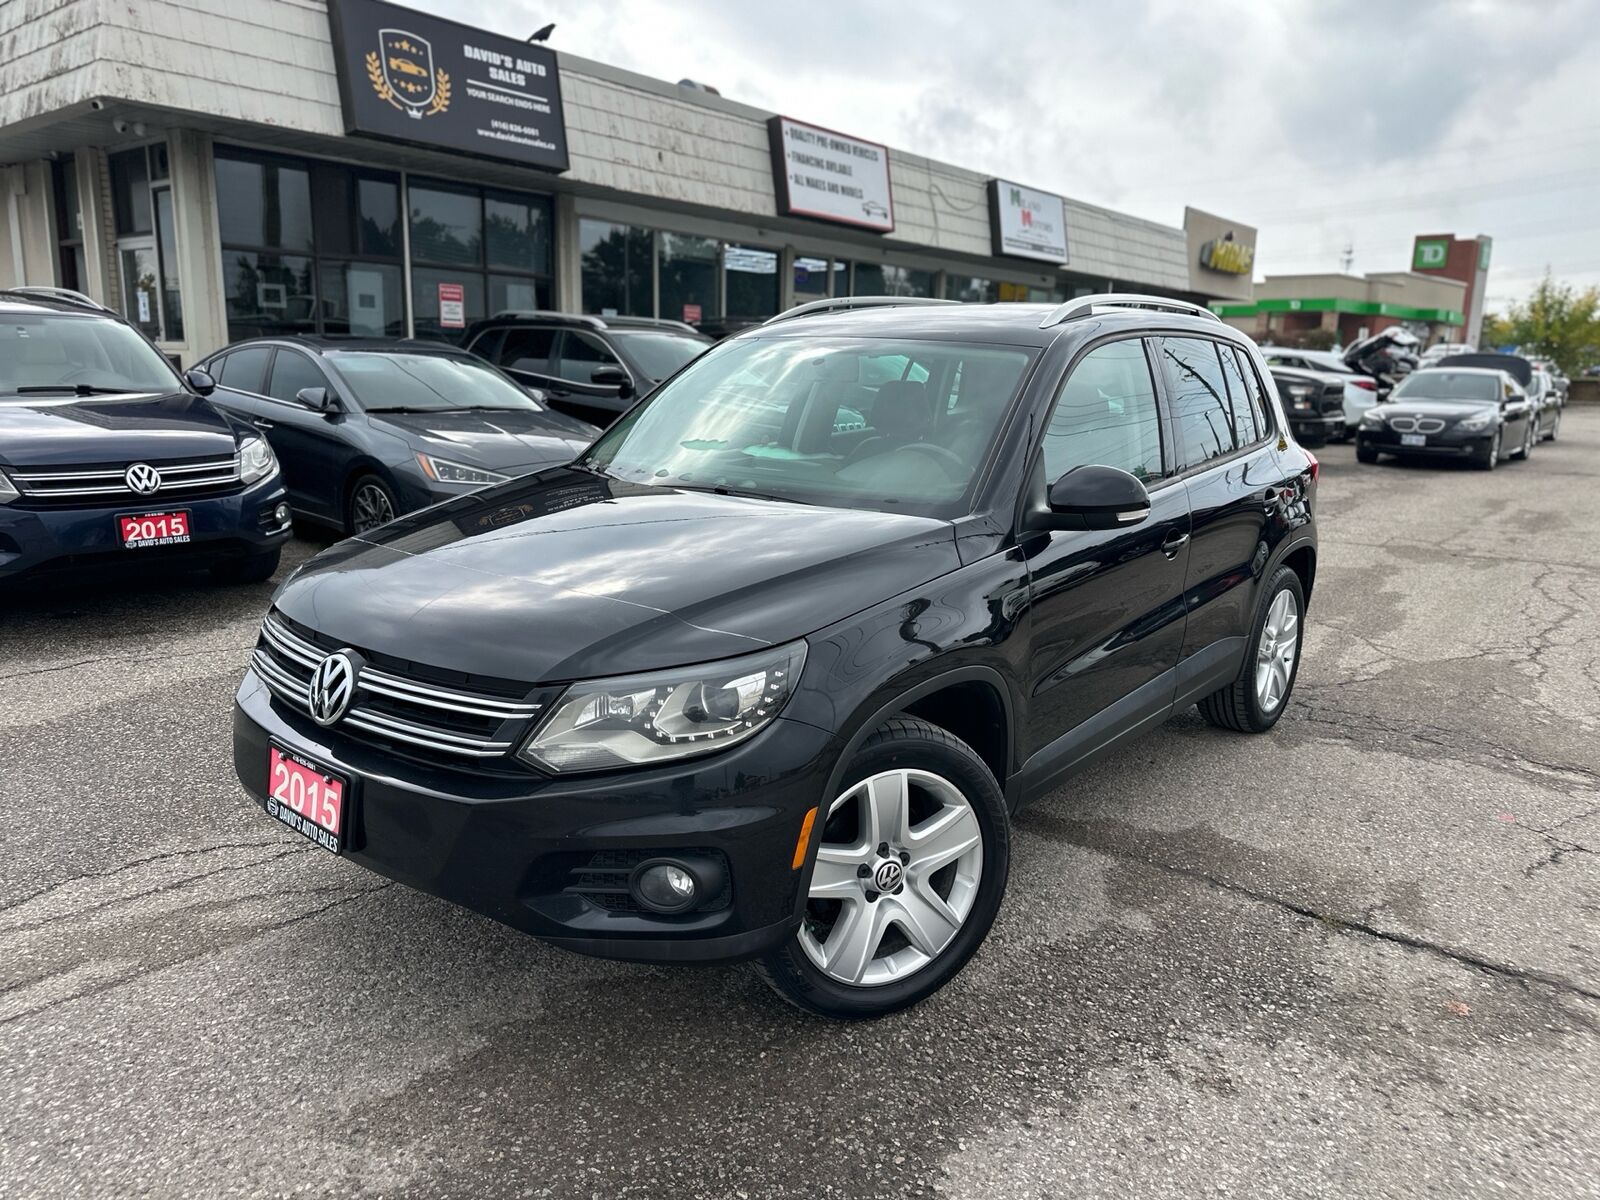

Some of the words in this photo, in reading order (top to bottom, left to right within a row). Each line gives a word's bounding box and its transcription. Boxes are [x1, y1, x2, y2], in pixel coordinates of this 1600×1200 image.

[463, 44, 513, 69] DAVID'S
[516, 58, 547, 77] AUTO
[488, 66, 526, 87] SALES
[466, 87, 487, 99] YOUR
[487, 92, 514, 106] SEARCH
[514, 98, 532, 110] ENDS
[533, 102, 551, 114] HERE
[790, 127, 815, 146] QUALITY
[816, 135, 851, 155] PRE-OWNED
[852, 144, 879, 162] VEHICLES
[791, 150, 824, 170] FINANCING
[794, 173, 804, 187] ALL
[805, 176, 826, 192] MAKES
[827, 181, 840, 194] AND
[841, 185, 864, 200] MODELS
[1419, 245, 1444, 263] TD
[126, 518, 185, 542] 2015
[137, 538, 159, 548] DAVID'S
[159, 537, 173, 545] AUTO
[173, 535, 191, 543] SALES
[273, 763, 338, 832] 2015
[279, 806, 302, 831] DAVID'S
[302, 820, 318, 840] AUTO
[318, 829, 338, 853] SALES
